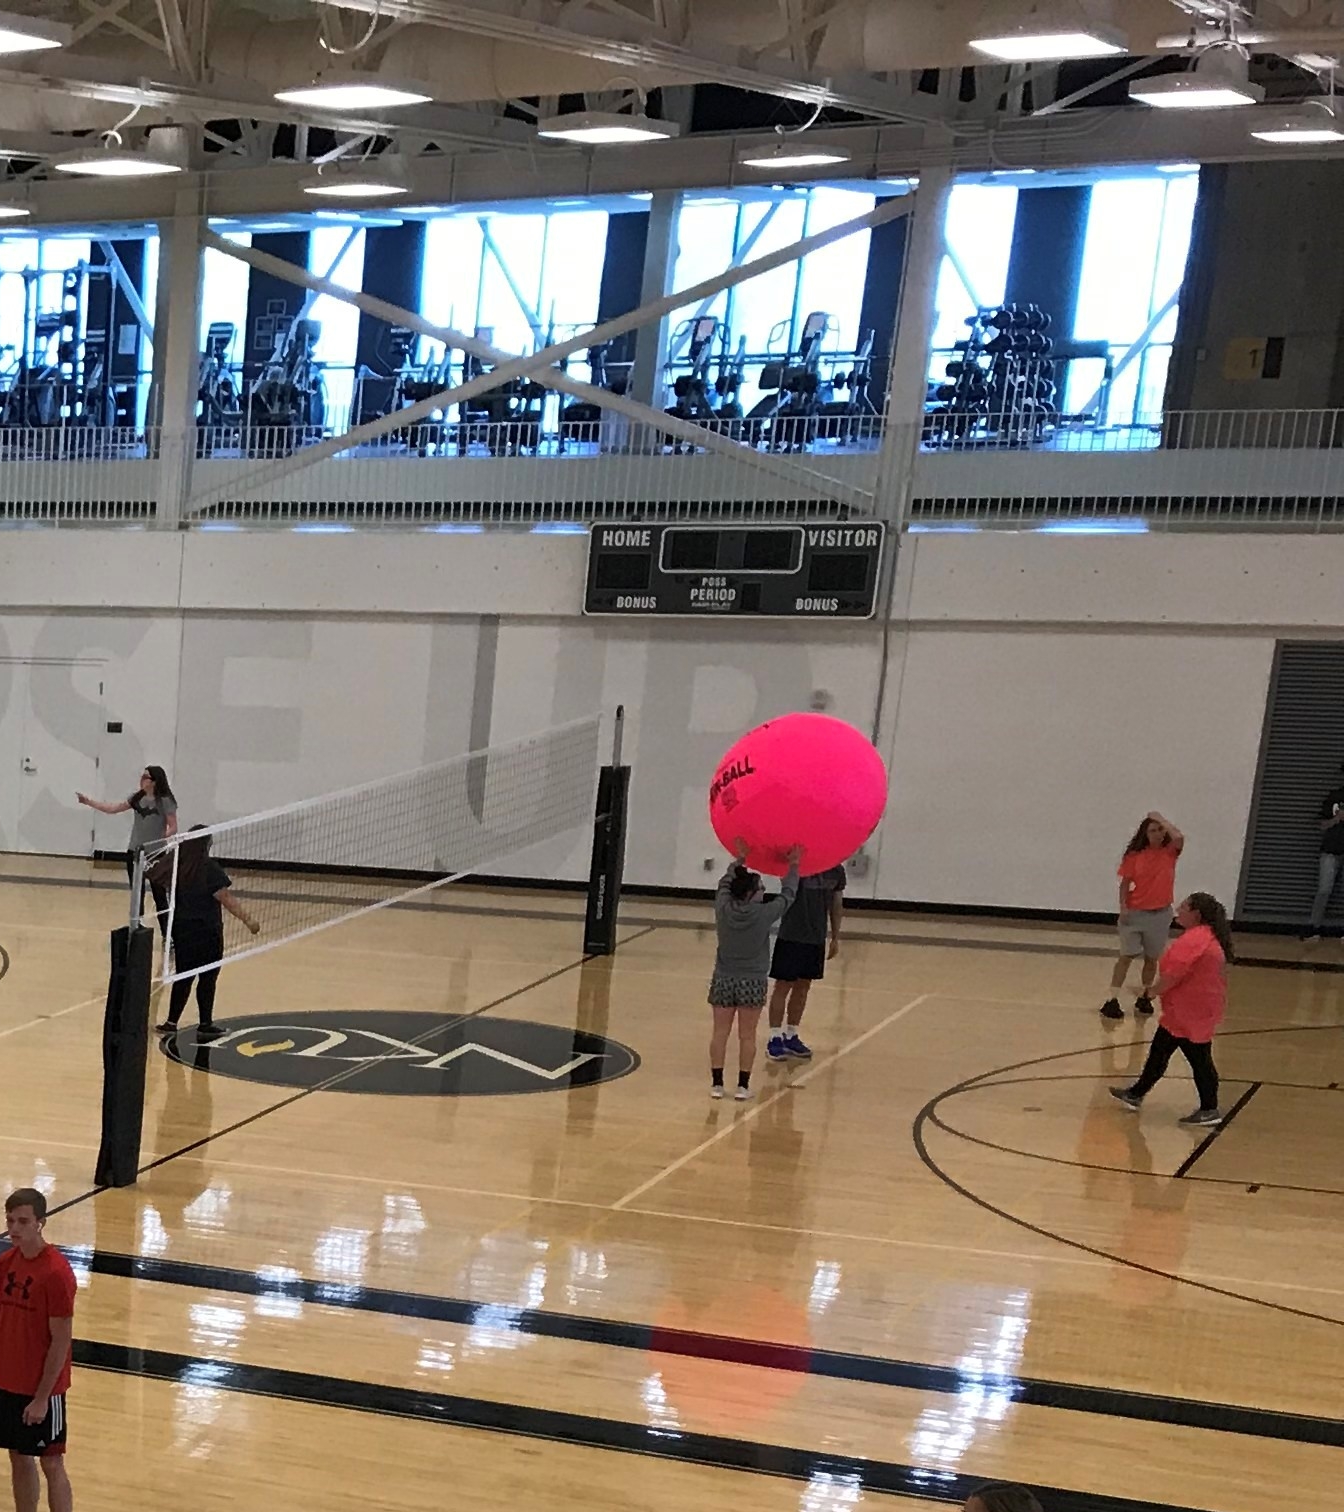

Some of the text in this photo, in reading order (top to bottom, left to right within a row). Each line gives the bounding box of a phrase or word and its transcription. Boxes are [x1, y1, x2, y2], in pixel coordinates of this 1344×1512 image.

[602, 530, 652, 547] HOME
[808, 529, 878, 547] VISITOR
[701, 577, 727, 587] POSS
[690, 588, 736, 601] PERIOD
[616, 596, 657, 609] BONUS
[795, 598, 839, 611] BONUS
